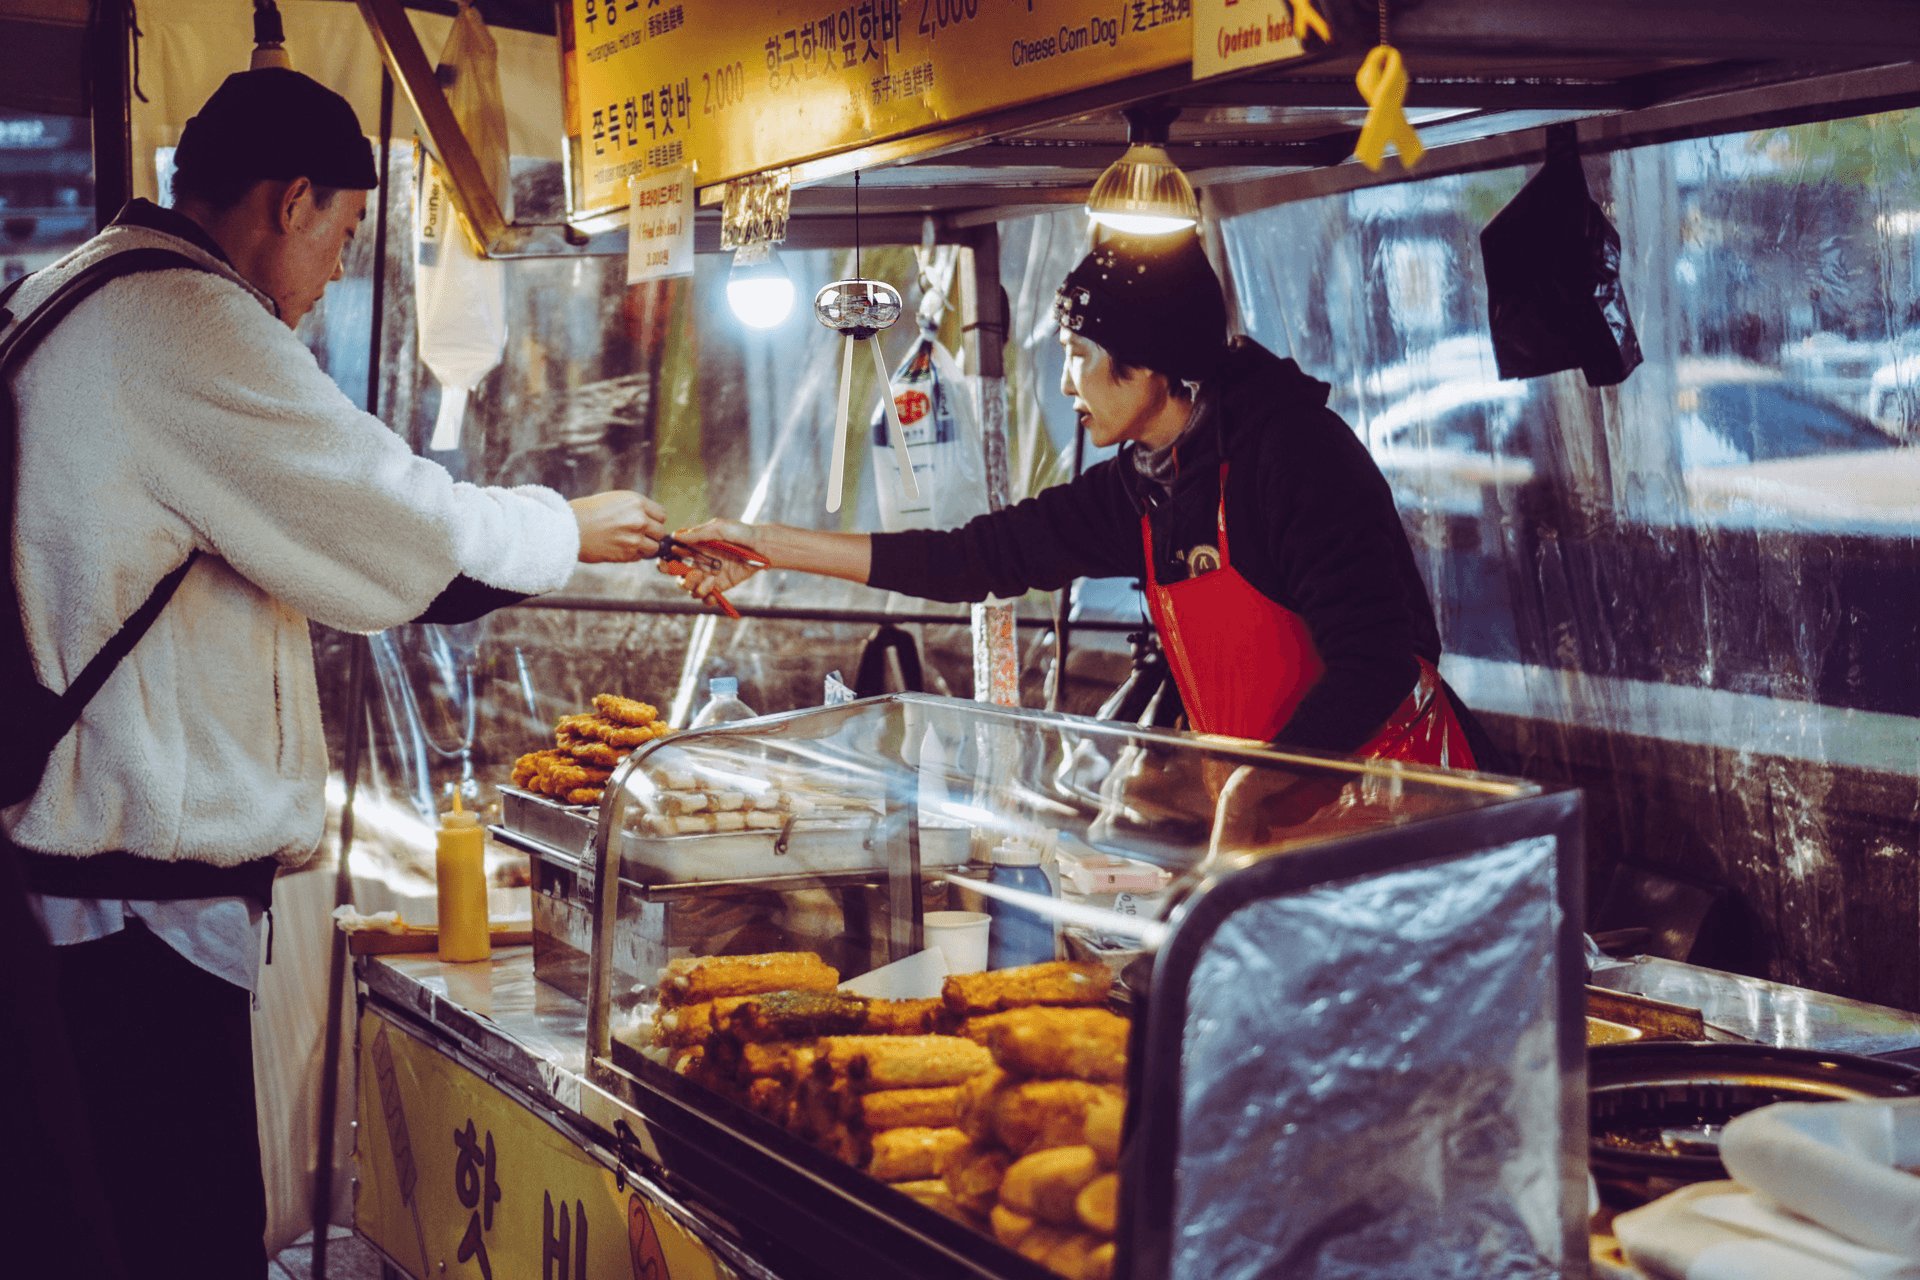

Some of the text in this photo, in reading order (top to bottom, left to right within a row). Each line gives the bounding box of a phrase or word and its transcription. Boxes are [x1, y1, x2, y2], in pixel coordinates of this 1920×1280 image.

[1011, 35, 1056, 67] Cheese
[1058, 26, 1088, 54] Corn
[1091, 16, 1117, 47] Dog
[592, 60, 744, 155] 쫀득한떡핫바 2,000
